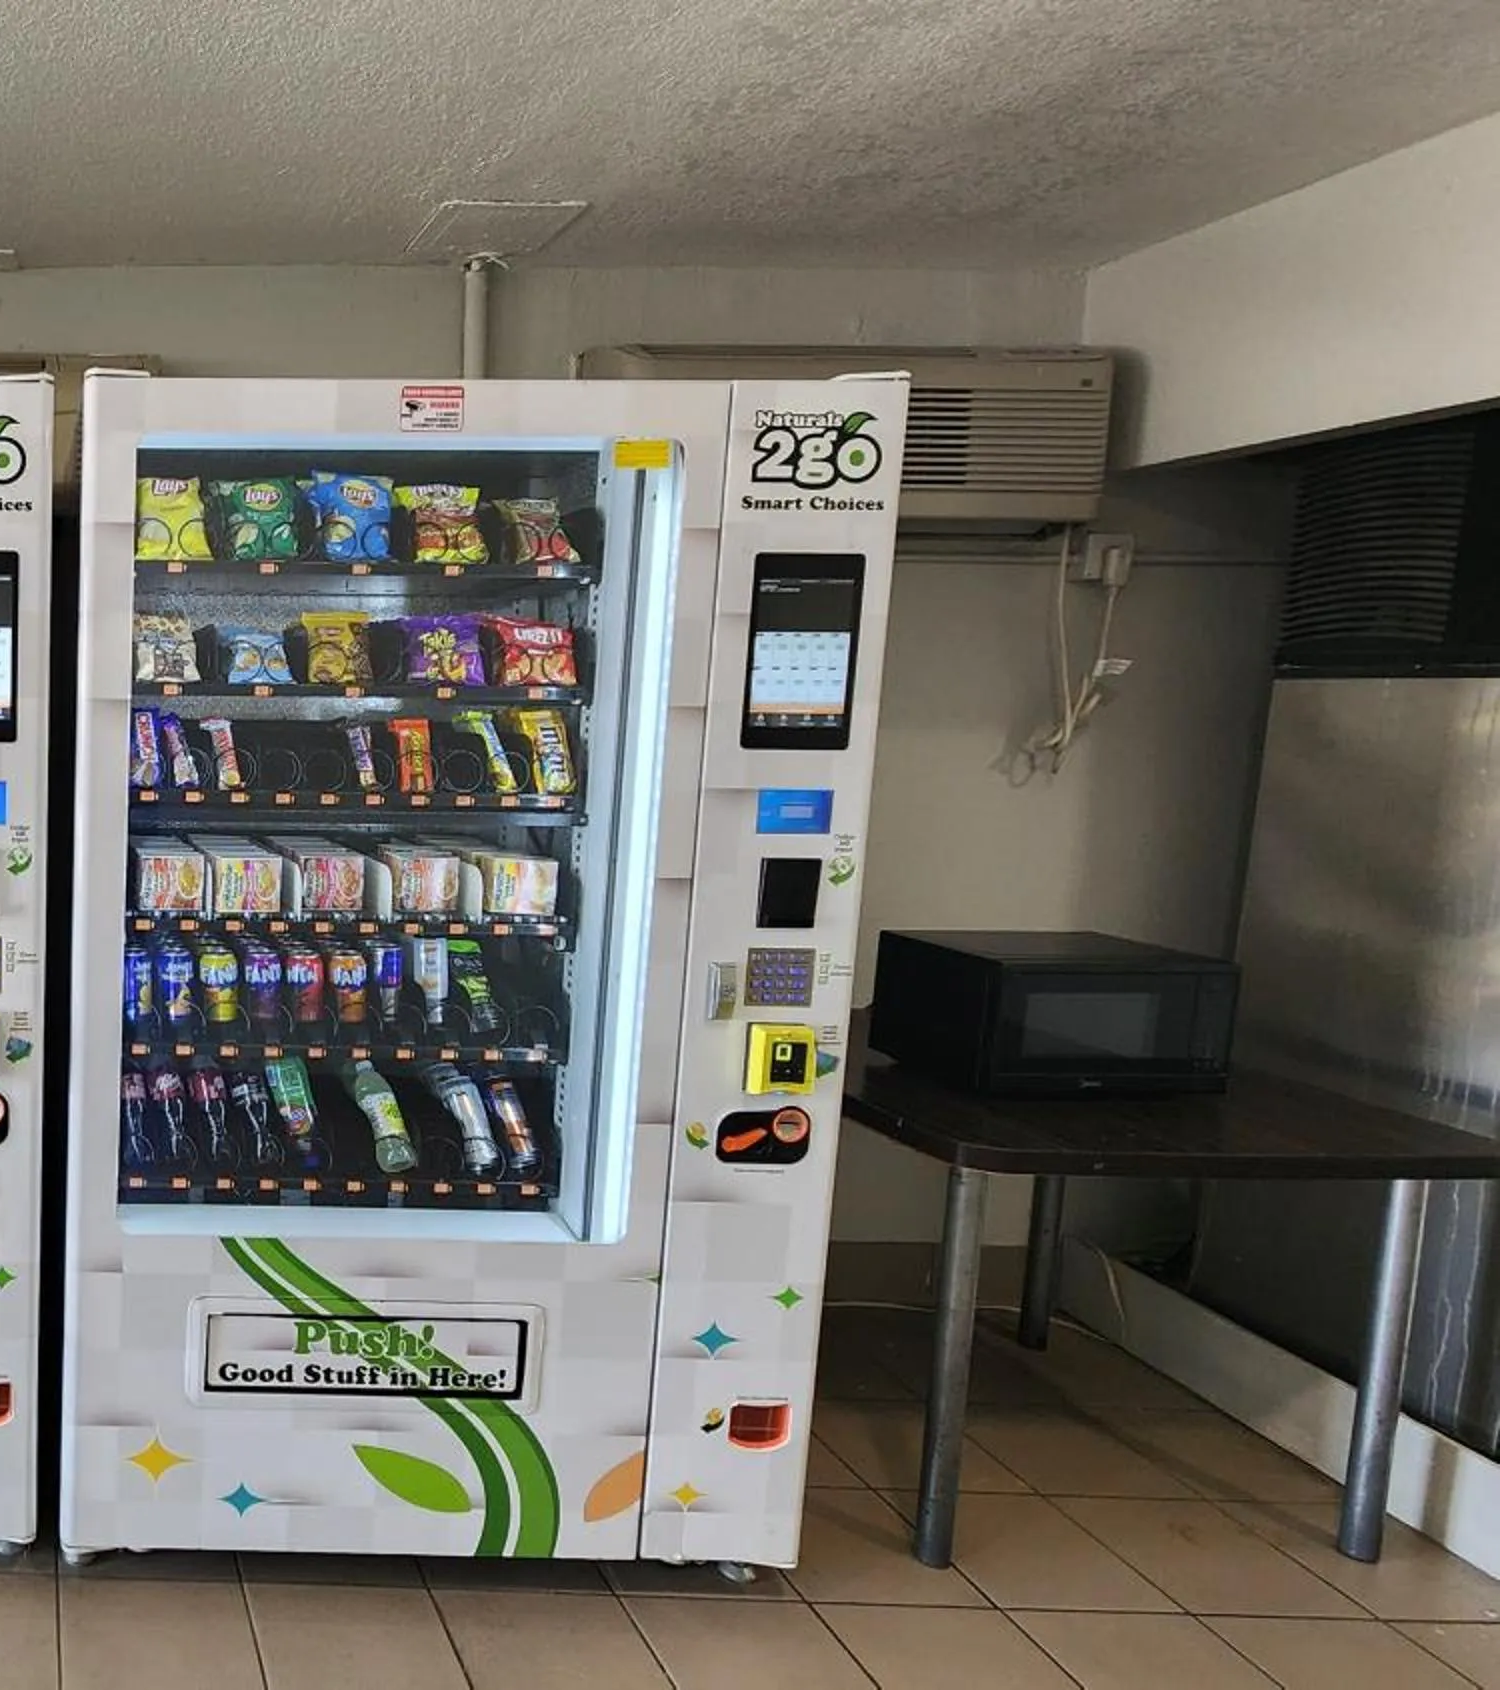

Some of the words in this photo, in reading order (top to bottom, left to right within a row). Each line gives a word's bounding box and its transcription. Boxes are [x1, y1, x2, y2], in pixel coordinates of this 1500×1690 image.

[755, 410, 844, 428] Naturals
[752, 426, 882, 490] 2go
[741, 495, 803, 511] Smart
[809, 495, 884, 511] Choices
[293, 1321, 435, 1360] Push!
[218, 1363, 293, 1383] Good
[303, 1364, 380, 1386] Stuff
[390, 1366, 418, 1387] in
[428, 1367, 508, 1389] Here!
